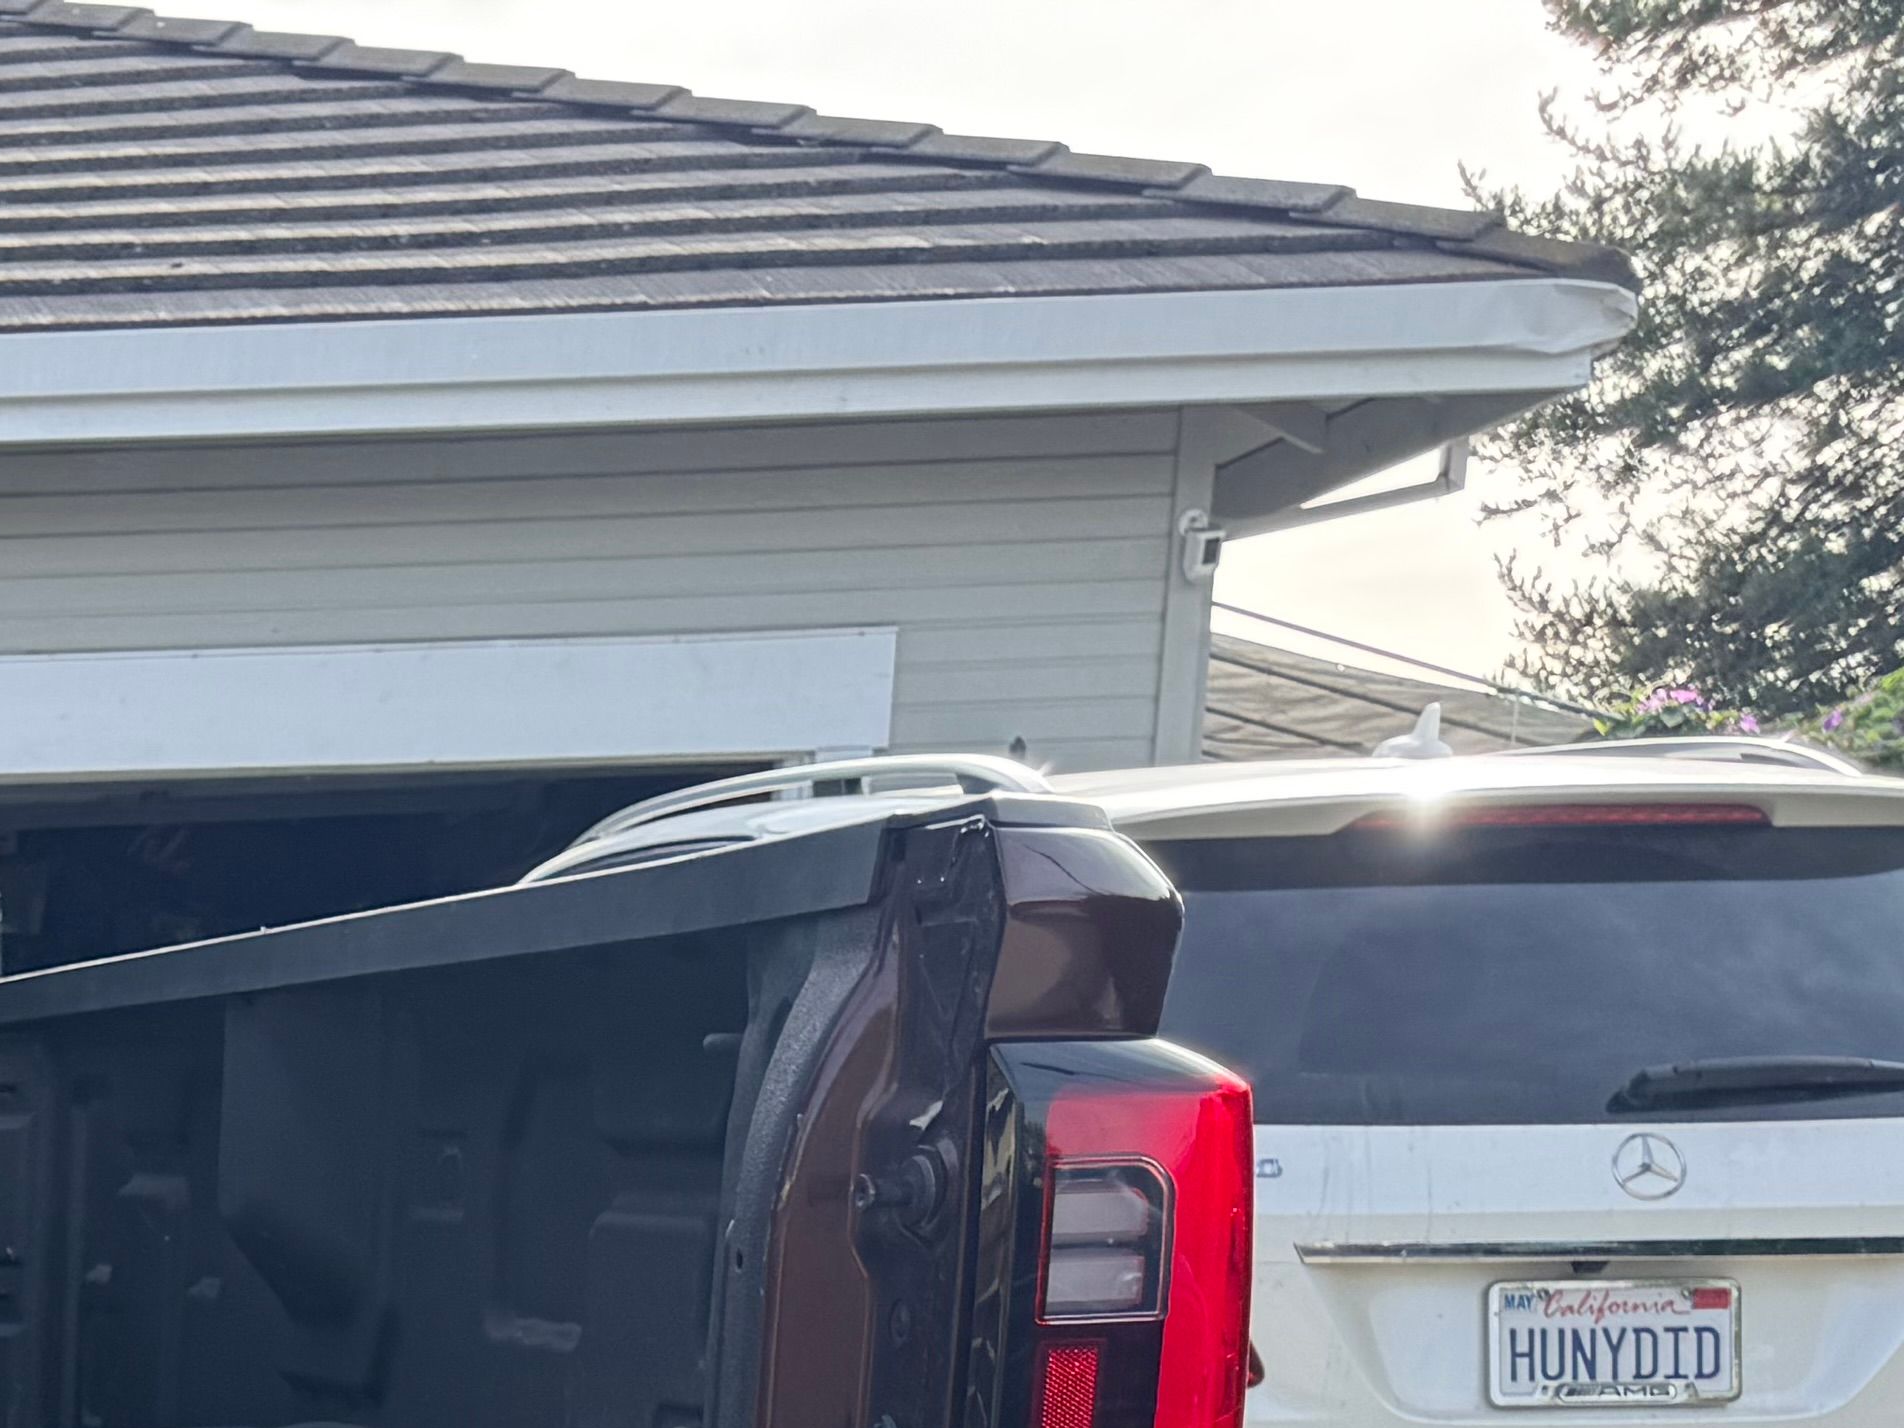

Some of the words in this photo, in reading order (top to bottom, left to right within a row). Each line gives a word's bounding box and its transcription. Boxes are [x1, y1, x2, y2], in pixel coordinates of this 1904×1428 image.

[1504, 1293, 1534, 1311] MAY
[1542, 1288, 1690, 1324] California
[1509, 1325, 1721, 1382] HUNYDID
